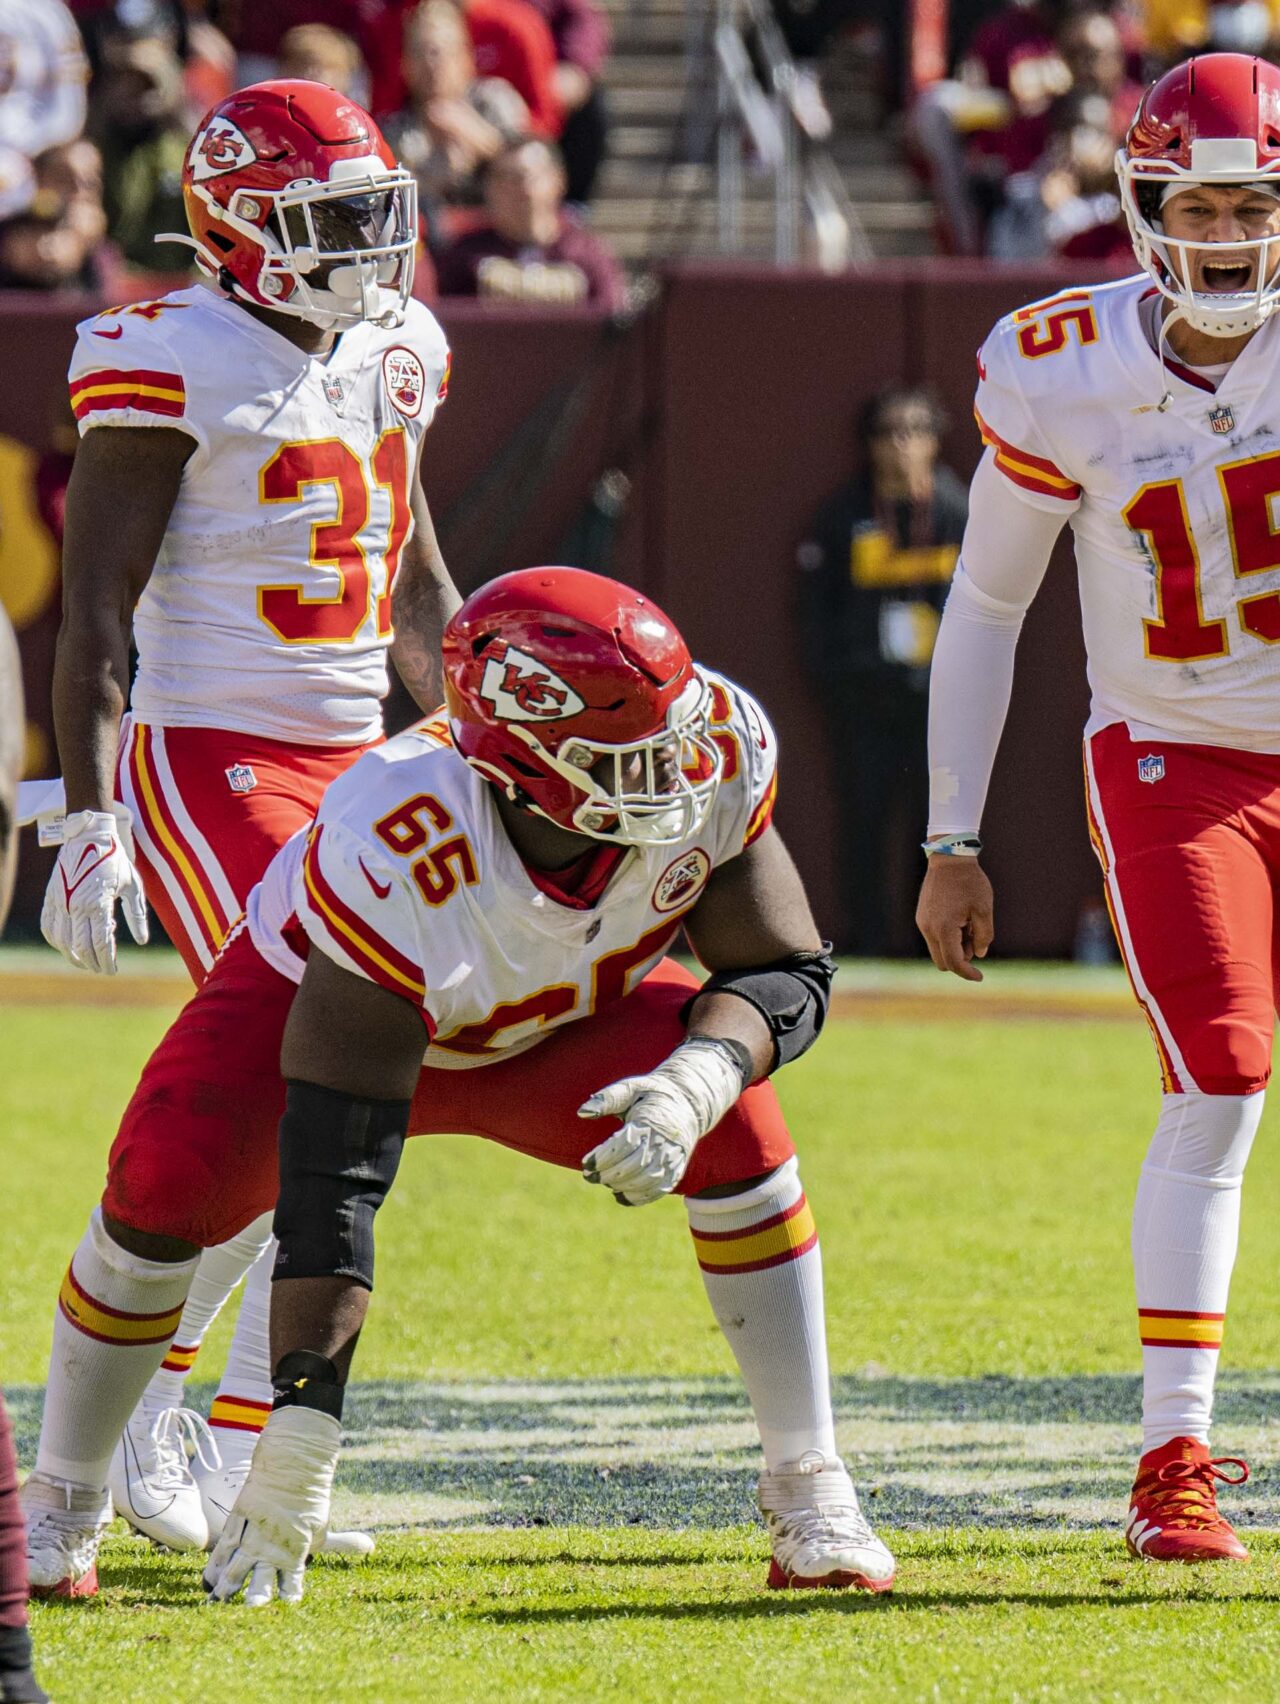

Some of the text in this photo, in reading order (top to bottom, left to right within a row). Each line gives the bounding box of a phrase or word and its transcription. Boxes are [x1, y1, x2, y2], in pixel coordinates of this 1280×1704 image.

[198, 127, 245, 169] KC
[1012, 290, 1099, 361] 15
[255, 425, 412, 644] 31
[499, 663, 568, 717] KC
[371, 792, 480, 910] 65
